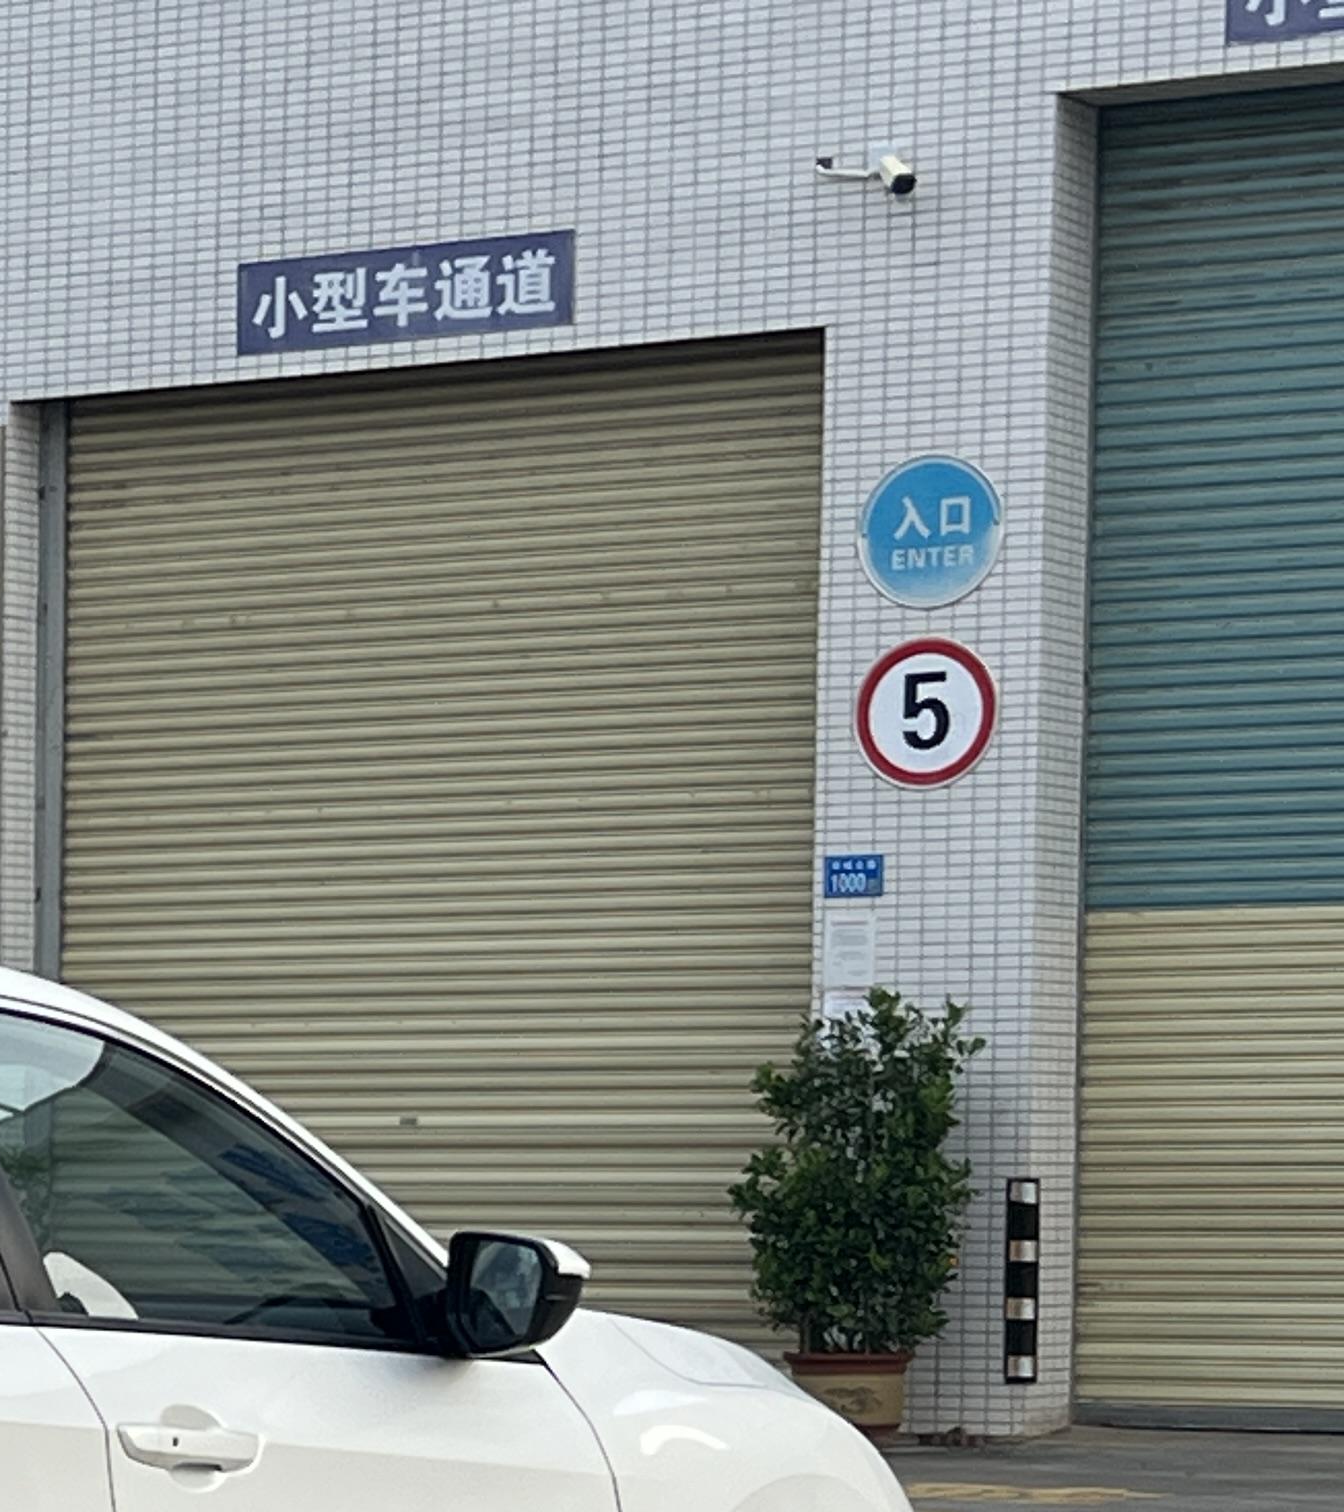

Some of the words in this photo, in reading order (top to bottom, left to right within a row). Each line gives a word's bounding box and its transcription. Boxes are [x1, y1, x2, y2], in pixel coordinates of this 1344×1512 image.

[252, 249, 557, 341] 小型车通道
[893, 497, 972, 540] 入口
[891, 545, 975, 571] ENTER
[903, 671, 951, 751] 5
